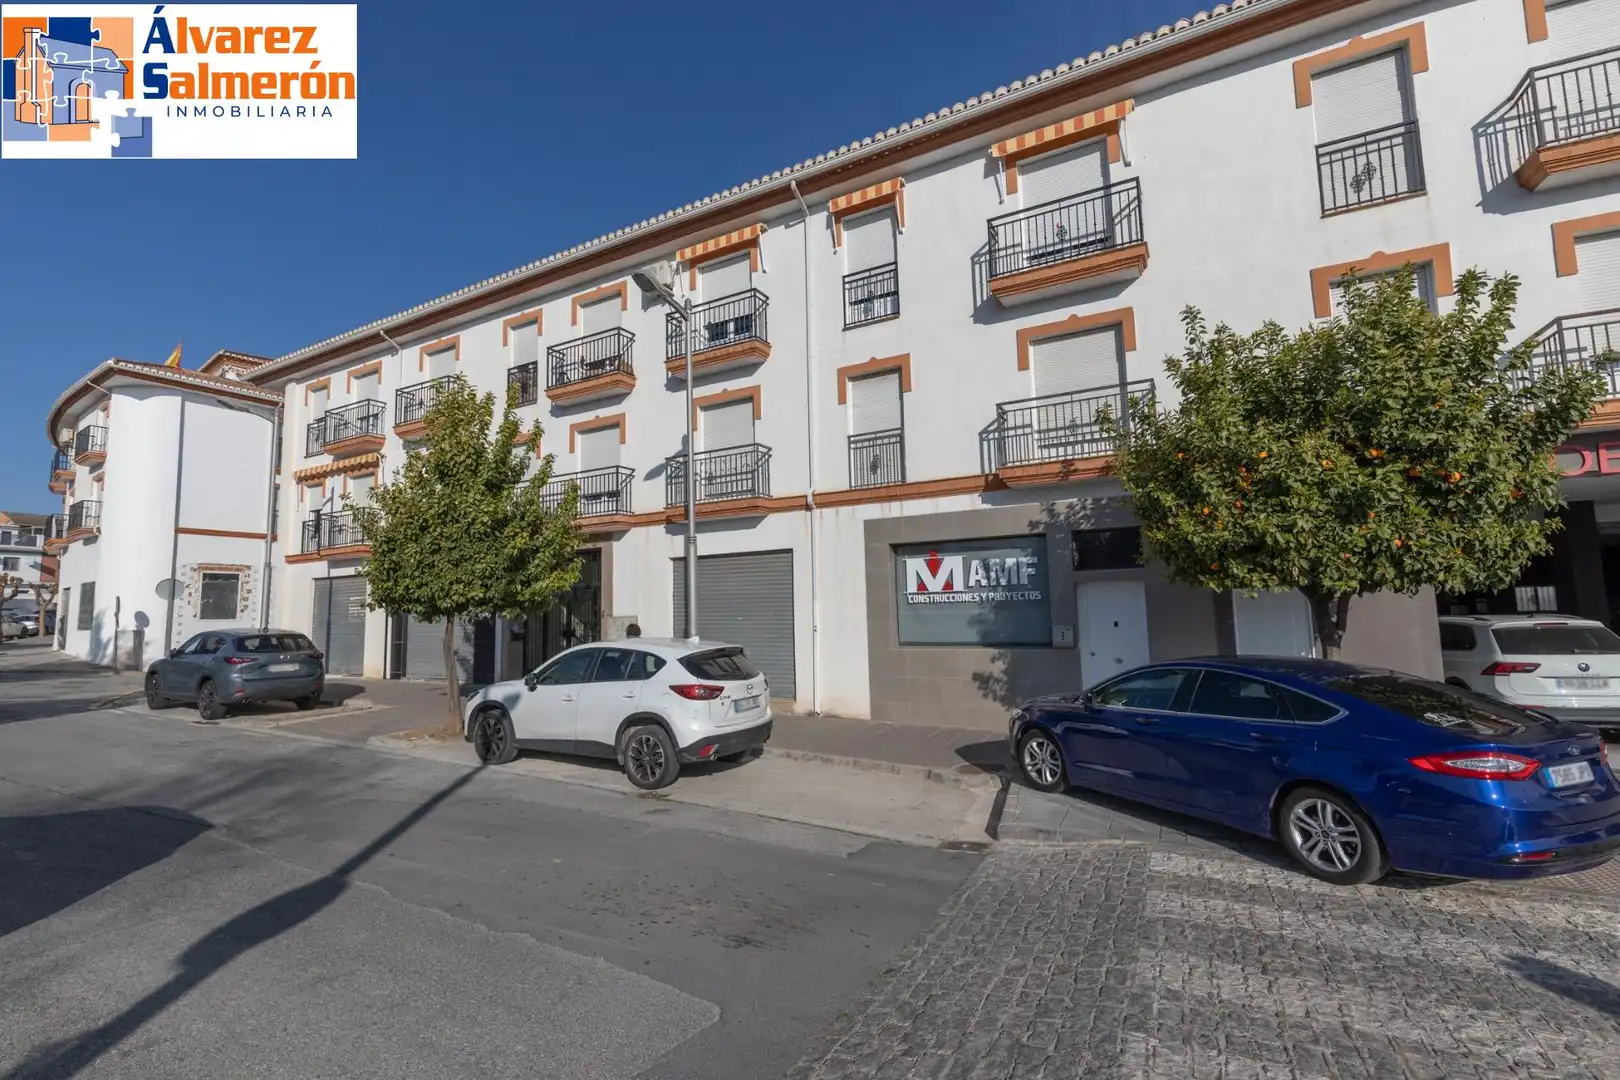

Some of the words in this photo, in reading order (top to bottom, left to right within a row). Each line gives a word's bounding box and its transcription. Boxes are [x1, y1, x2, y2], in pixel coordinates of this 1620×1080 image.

[908, 592, 979, 604] CONSTRUCCIONES
[979, 593, 987, 601] Y
[989, 590, 1042, 601] PROYECTOS
